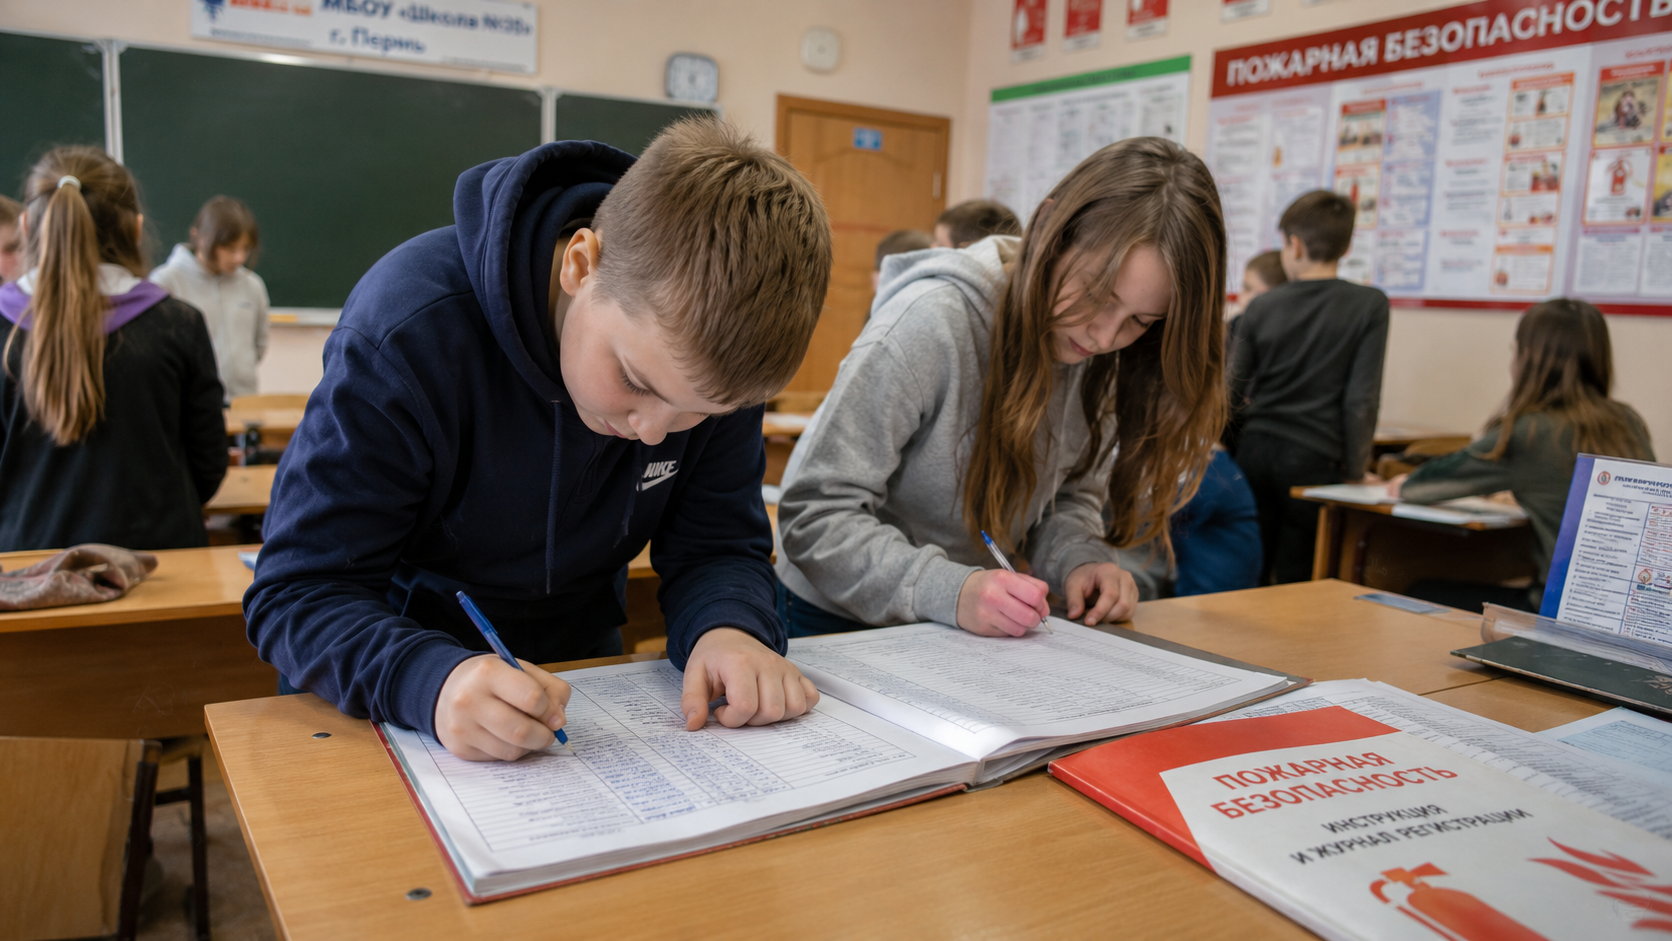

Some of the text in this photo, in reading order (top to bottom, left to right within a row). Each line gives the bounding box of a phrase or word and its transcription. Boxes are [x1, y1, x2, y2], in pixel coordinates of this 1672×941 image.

[321, 0, 394, 19] МБОУ
[351, 26, 427, 54] Пермь
[1226, 0, 1672, 87] ПОЖАРНАЯ БЕЗОПАСНОСТЬ
[643, 460, 677, 478] NIKE
[1212, 752, 1395, 790] ПОЖАРНАЯ
[1210, 766, 1459, 819] БЕЗОПАСНОСТЬ
[1321, 804, 1448, 834] ИНСТРУКЦИЯ
[1289, 808, 1534, 865] И ЖУРНАЛ РЕГИСТРАЦИИ
